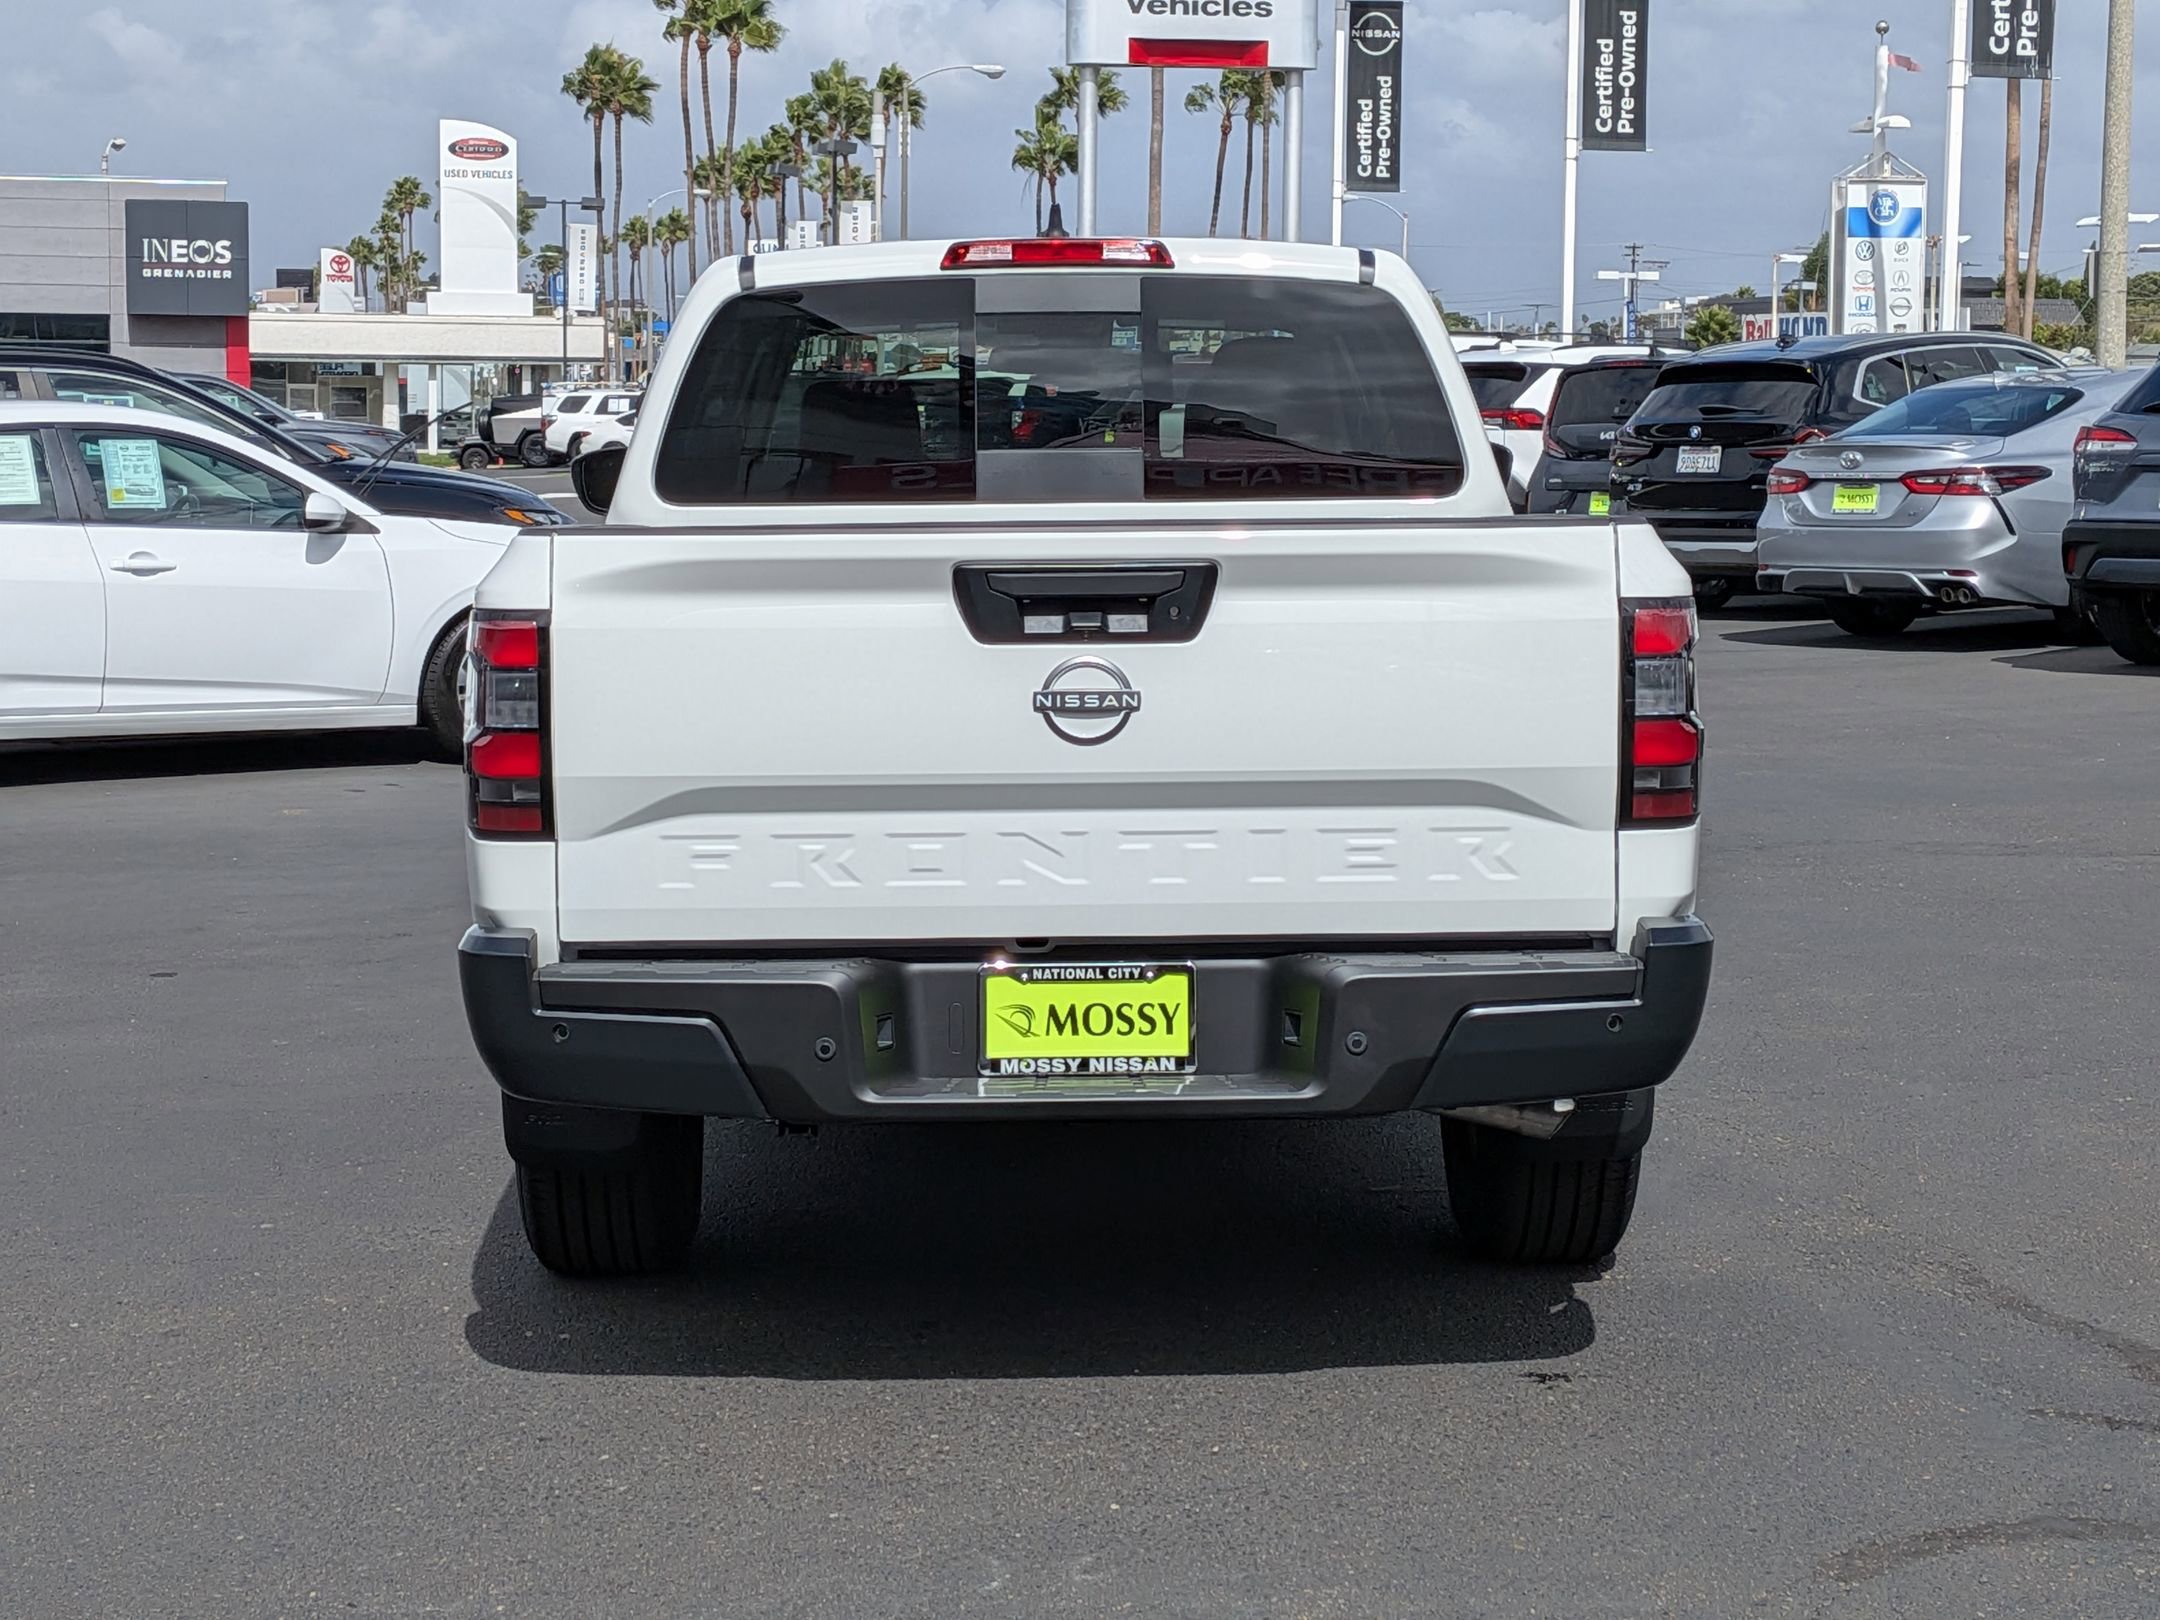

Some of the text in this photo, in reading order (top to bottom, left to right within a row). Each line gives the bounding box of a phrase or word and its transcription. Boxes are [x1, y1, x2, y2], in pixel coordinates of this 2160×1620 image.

[1127, 0, 1273, 18] Vehicles
[1351, 29, 1400, 39] NISSAN
[1617, 10, 1637, 134] Pre-Owned
[1595, 38, 1614, 133] Certified
[1376, 75, 1392, 178] Pre-Owned
[1357, 98, 1373, 178] Certified
[444, 169, 513, 180] USED VEHICLES
[142, 238, 232, 264] INEOS
[142, 268, 232, 279] GRENADIER
[1036, 694, 1138, 707] NISSAN
[657, 827, 1522, 889] FRONTIER
[1032, 967, 1141, 980] NATIONAL CITY
[1046, 1002, 1181, 1037] MOSSY
[1000, 1057, 1176, 1074] MOSSY NISSAN
